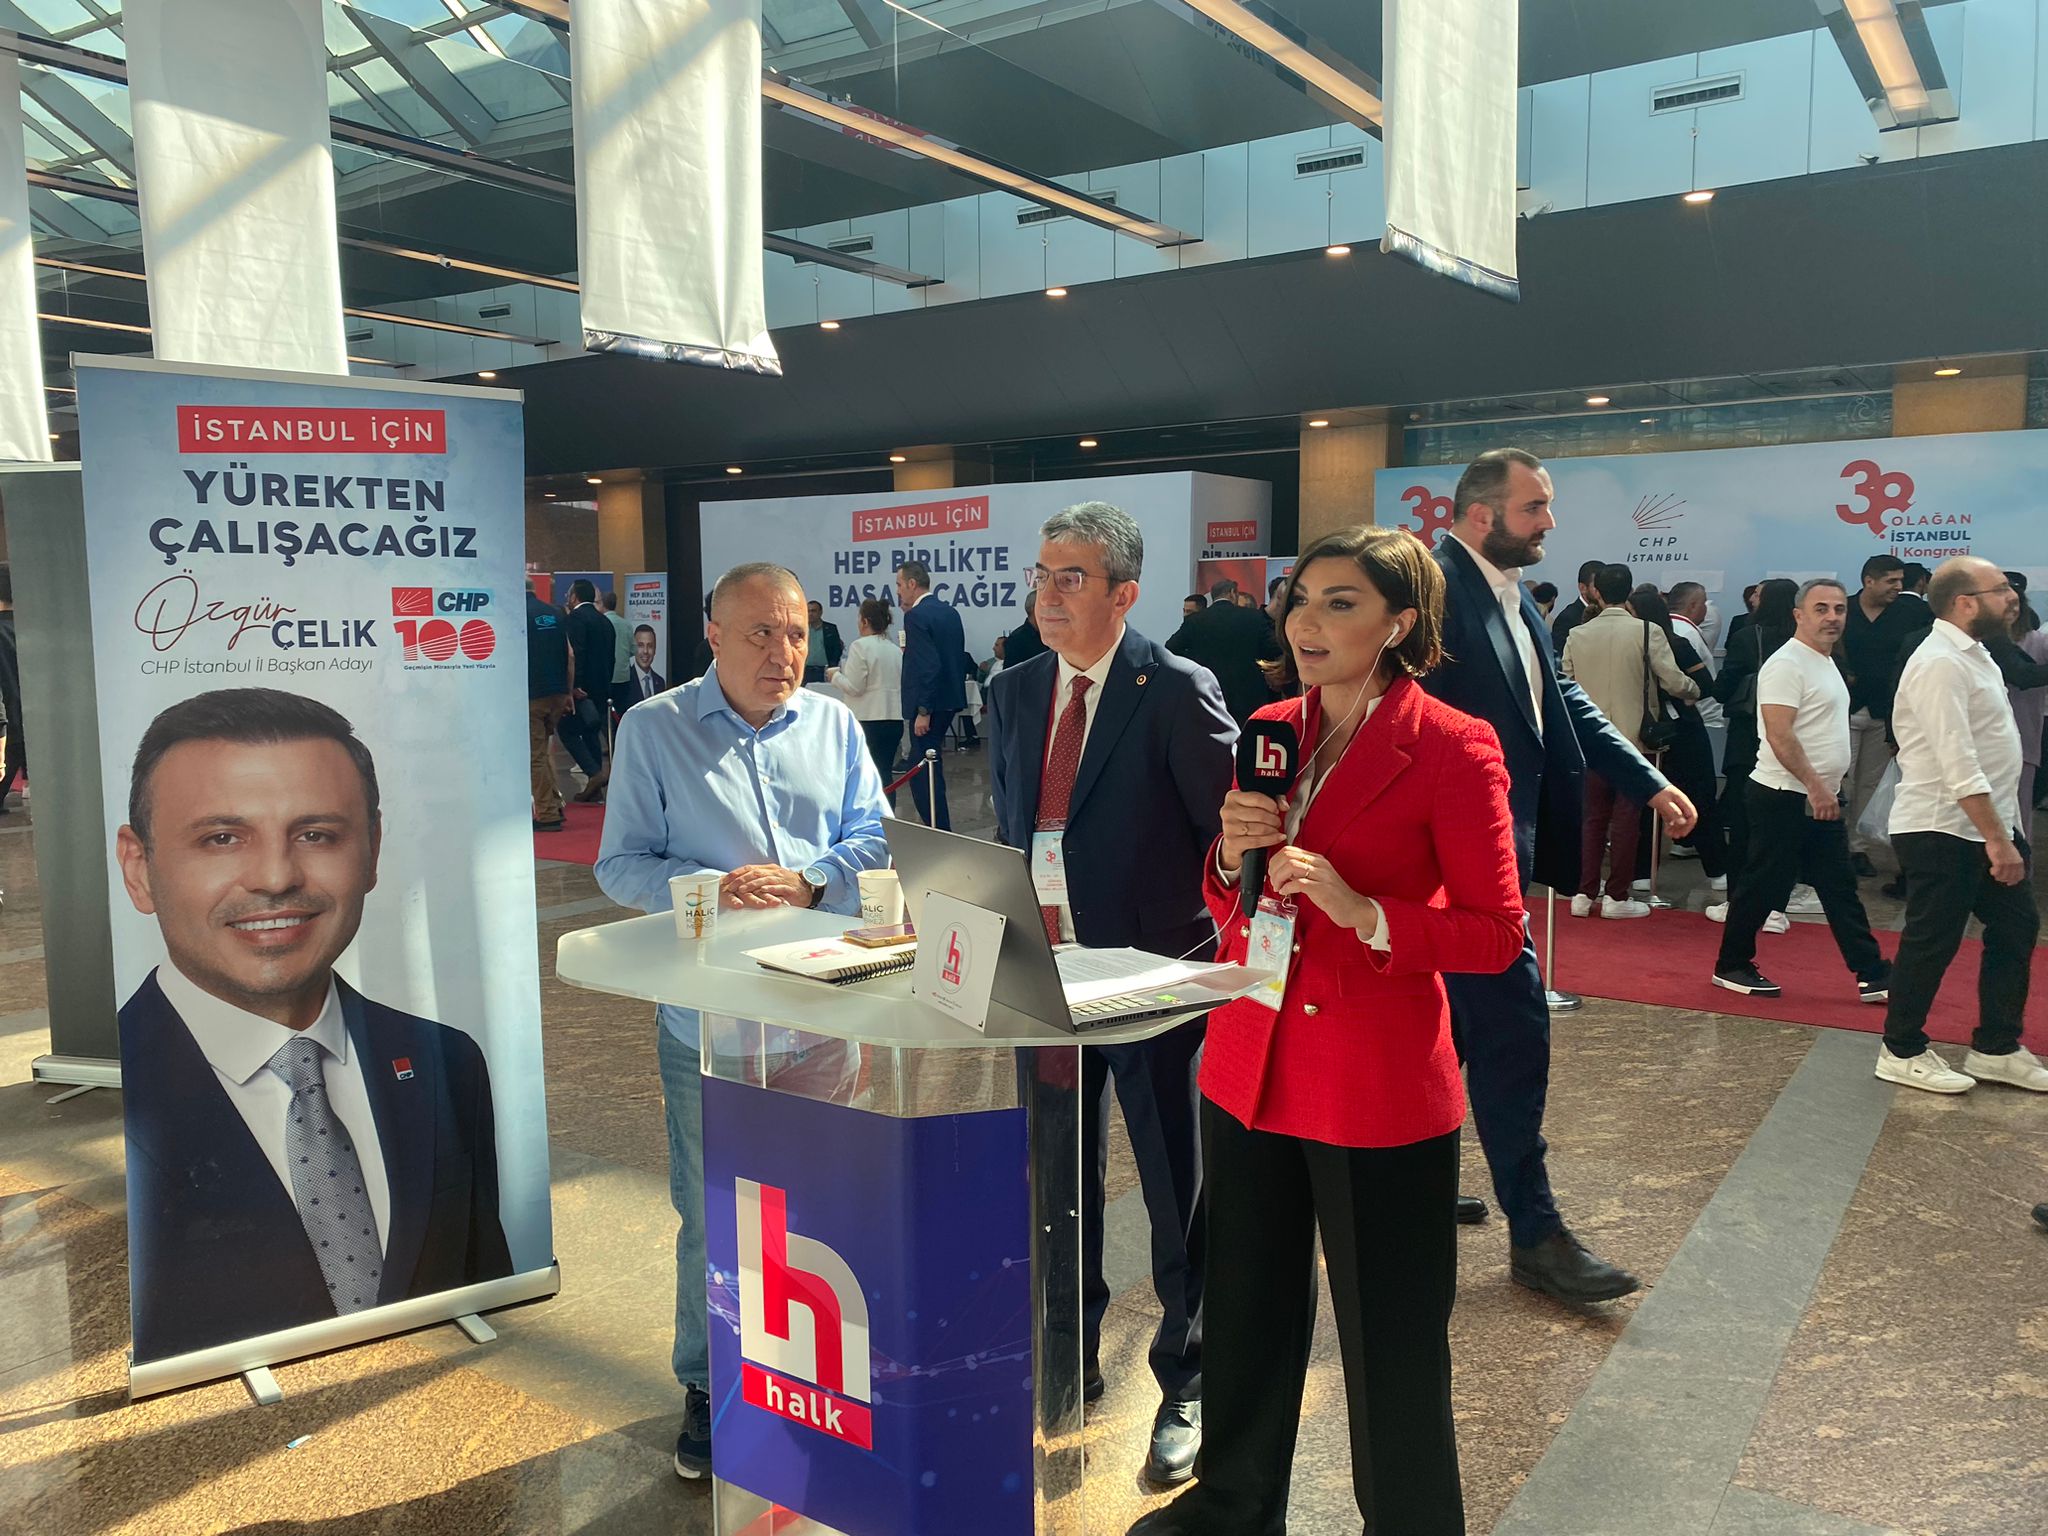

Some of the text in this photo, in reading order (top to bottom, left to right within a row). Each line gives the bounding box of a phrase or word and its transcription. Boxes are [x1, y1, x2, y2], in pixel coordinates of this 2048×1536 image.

[193, 414, 433, 448] İSTANBUL İÇİN
[183, 462, 446, 511] YÜREKTEN
[859, 504, 982, 533] İSTANBUL İÇİN
[1891, 512, 1972, 527] OLAĞAN
[149, 516, 478, 567] ÇALIŞACAĞIZ
[1639, 536, 1677, 547] CHP
[1890, 530, 1971, 542] İSTANBUL
[834, 551, 881, 574] HEP
[1626, 552, 1689, 563] İSTANBUL
[1904, 545, 1970, 559] Kongresi
[437, 592, 490, 612] CHP
[829, 575, 1017, 608] BAACAĞIZ
[135, 568, 296, 651] Özgür
[271, 620, 377, 650] ÇELİK
[393, 619, 496, 661] 100
[141, 656, 373, 675] CHP İstanbul İl Başkan Adayı
[1260, 769, 1281, 777] halk
[765, 1375, 844, 1434] halk
